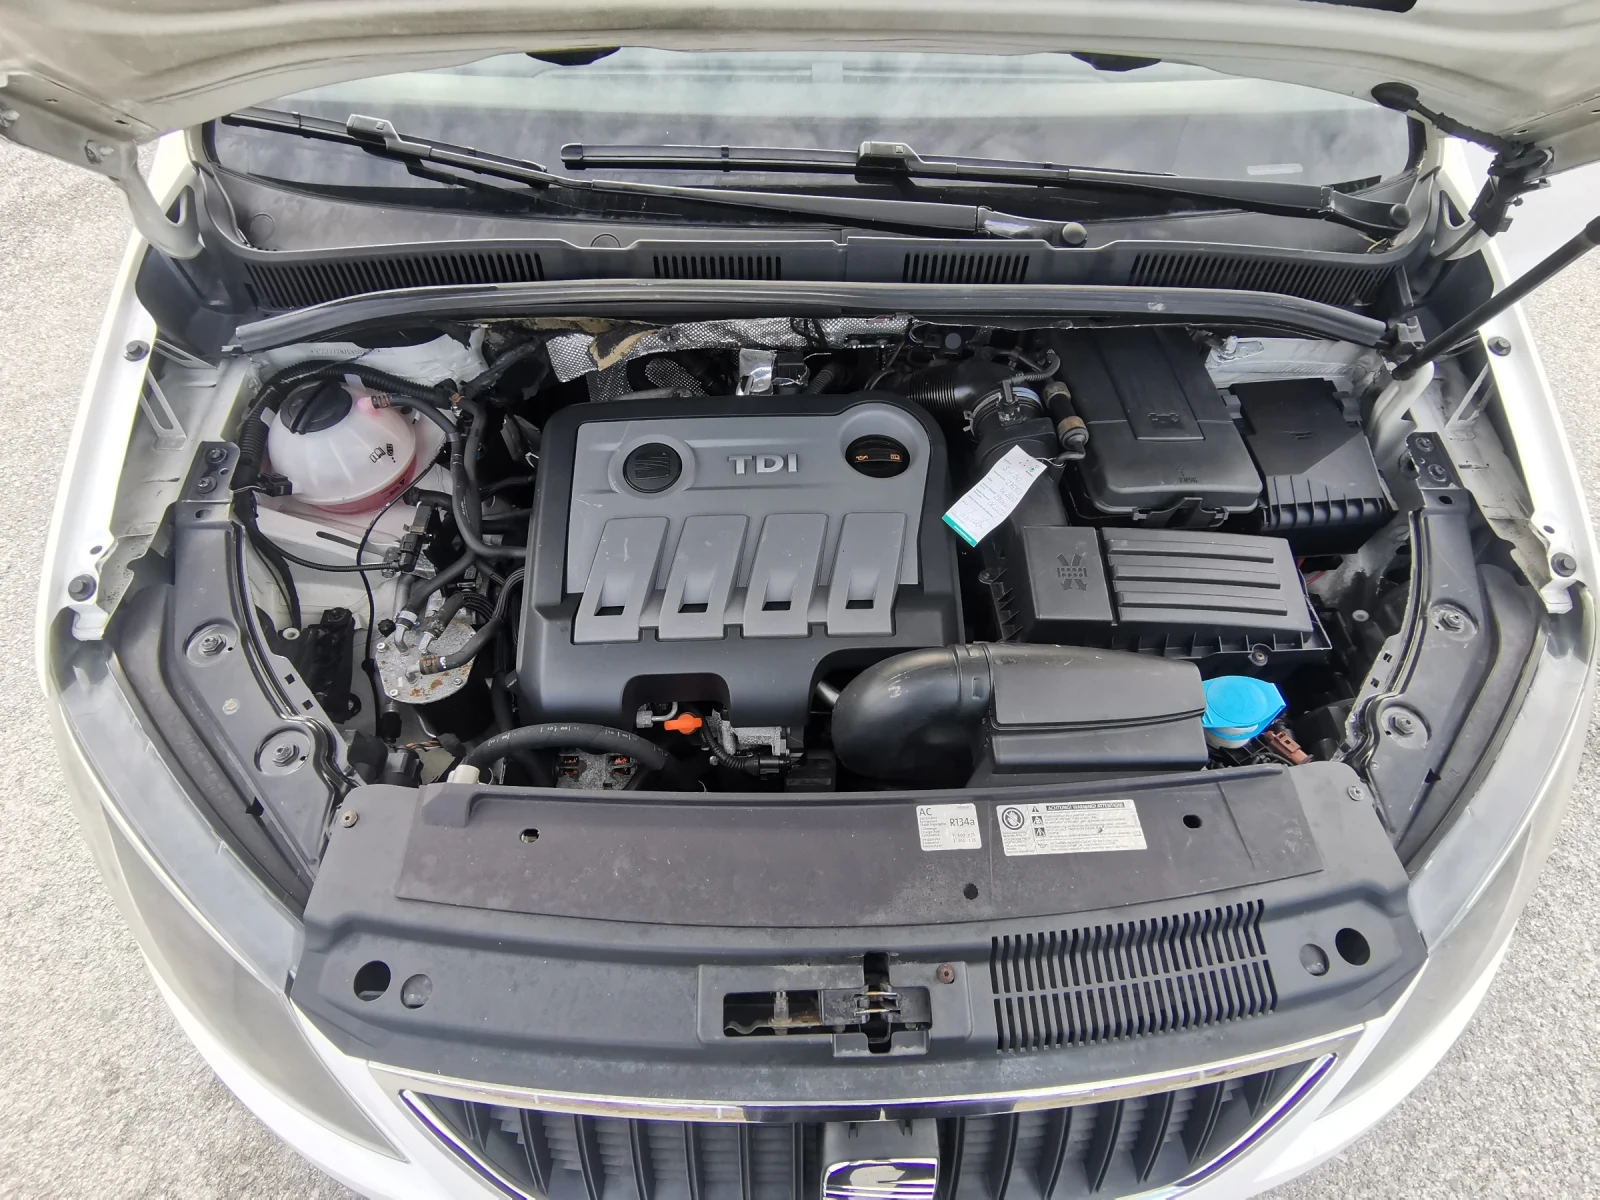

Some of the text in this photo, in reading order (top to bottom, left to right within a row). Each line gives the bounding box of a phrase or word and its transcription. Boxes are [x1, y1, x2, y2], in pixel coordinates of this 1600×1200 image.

[728, 453, 799, 475] TDI
[919, 807, 933, 816] AC
[949, 817, 976, 827] R134a
